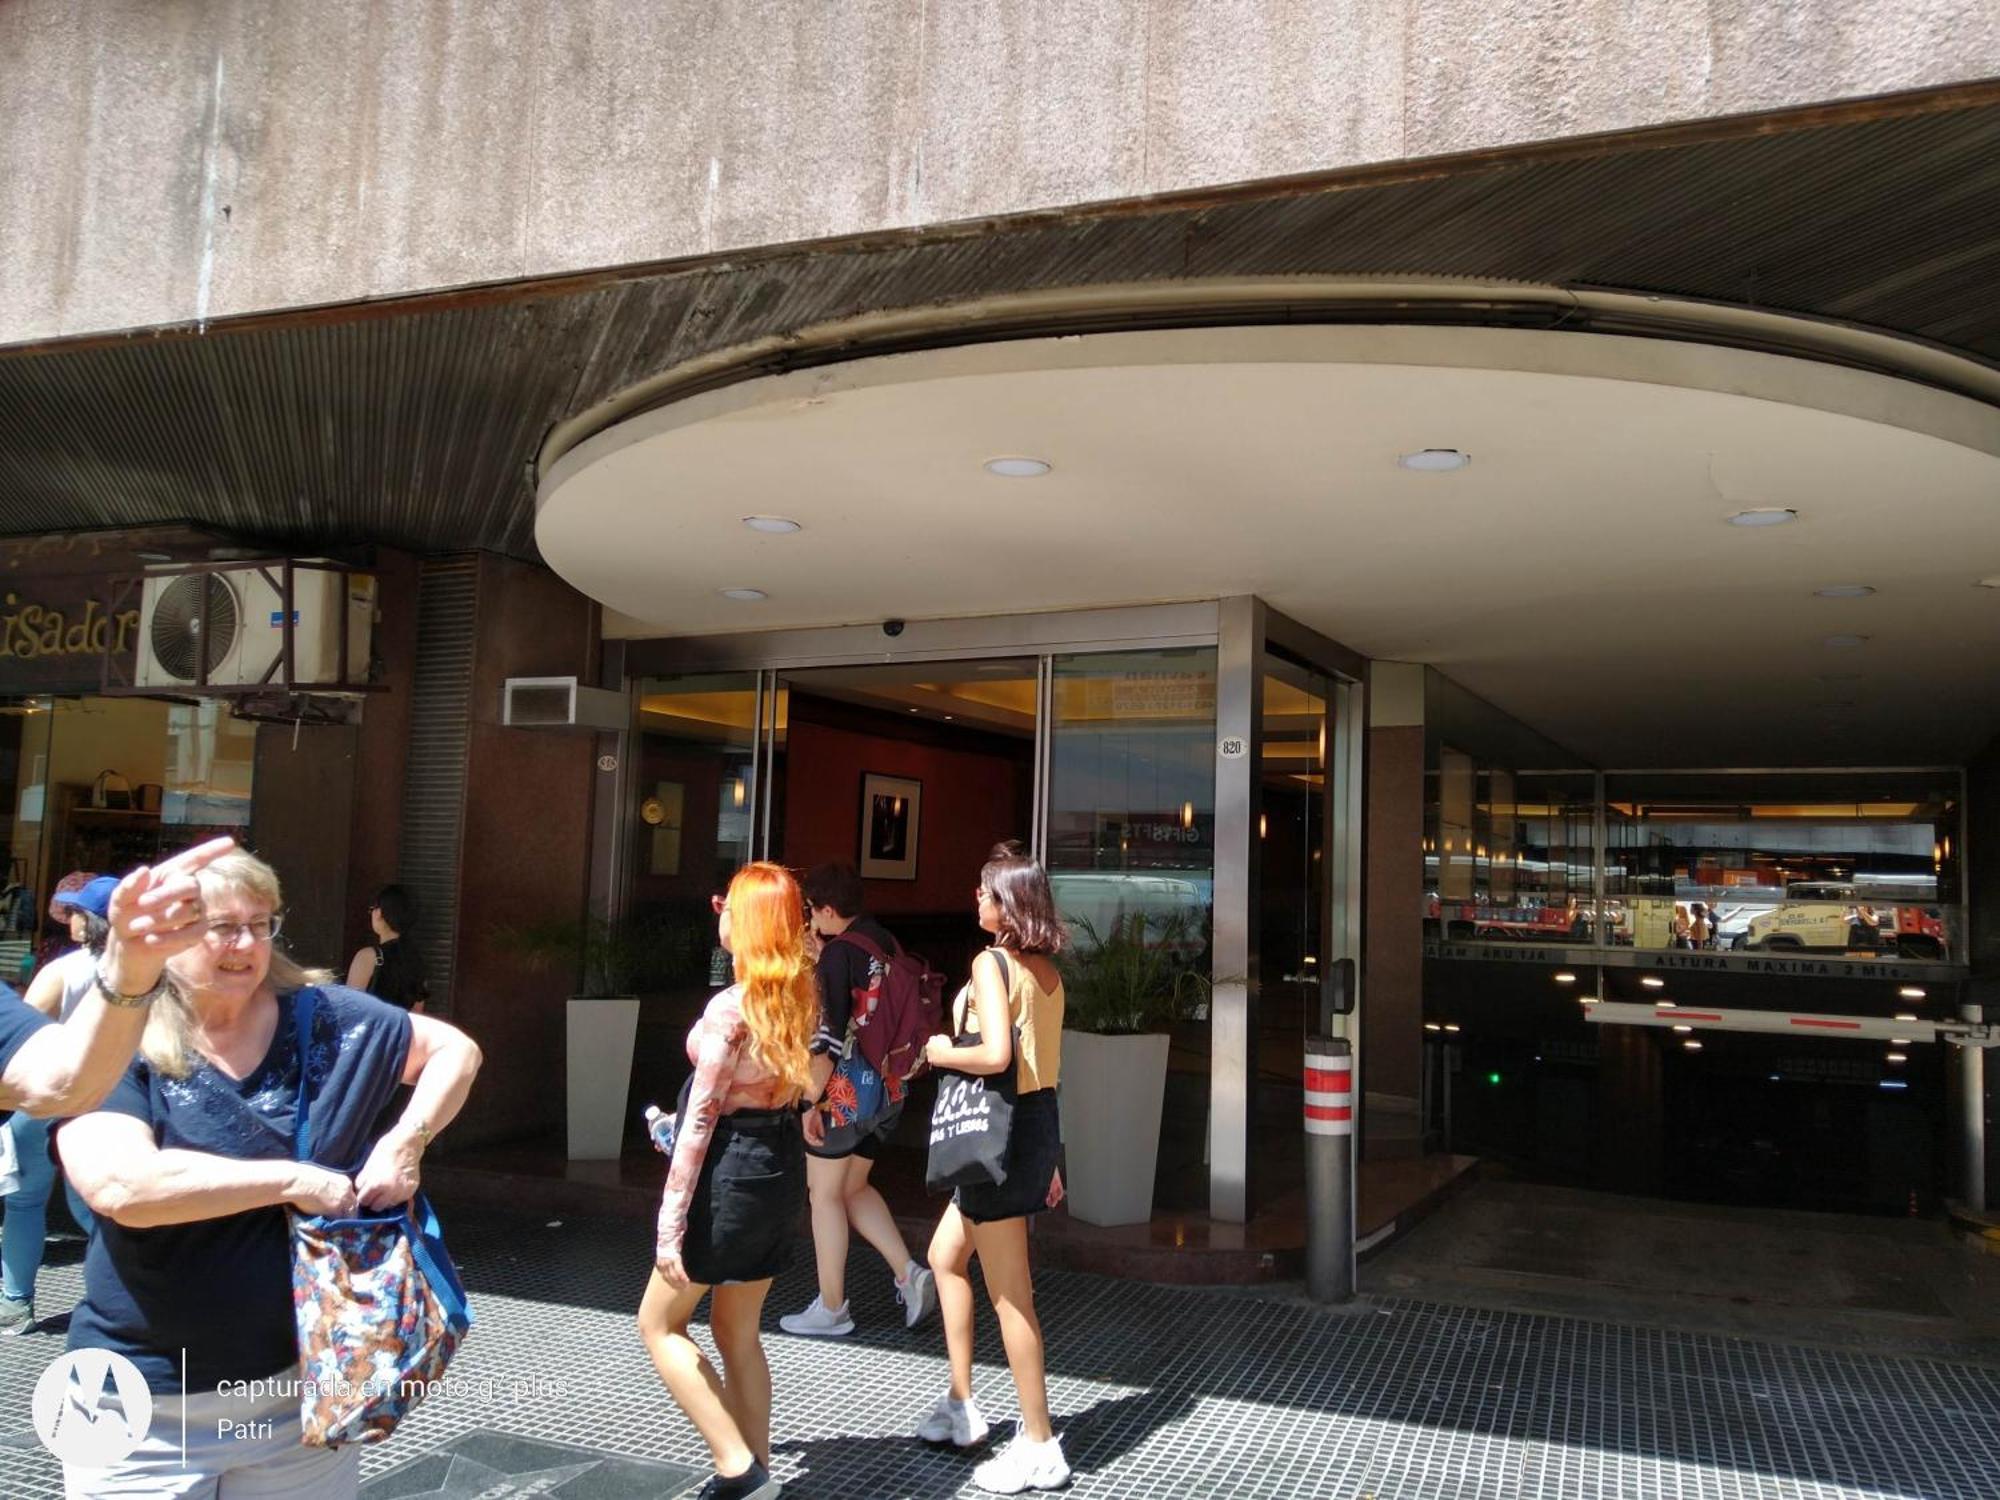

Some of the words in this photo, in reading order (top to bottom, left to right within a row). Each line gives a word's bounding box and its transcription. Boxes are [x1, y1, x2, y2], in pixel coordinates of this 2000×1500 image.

[1223, 740, 1241, 754] 820
[1655, 955, 1729, 970] ALTURA
[1746, 959, 1830, 976] MAXIMA
